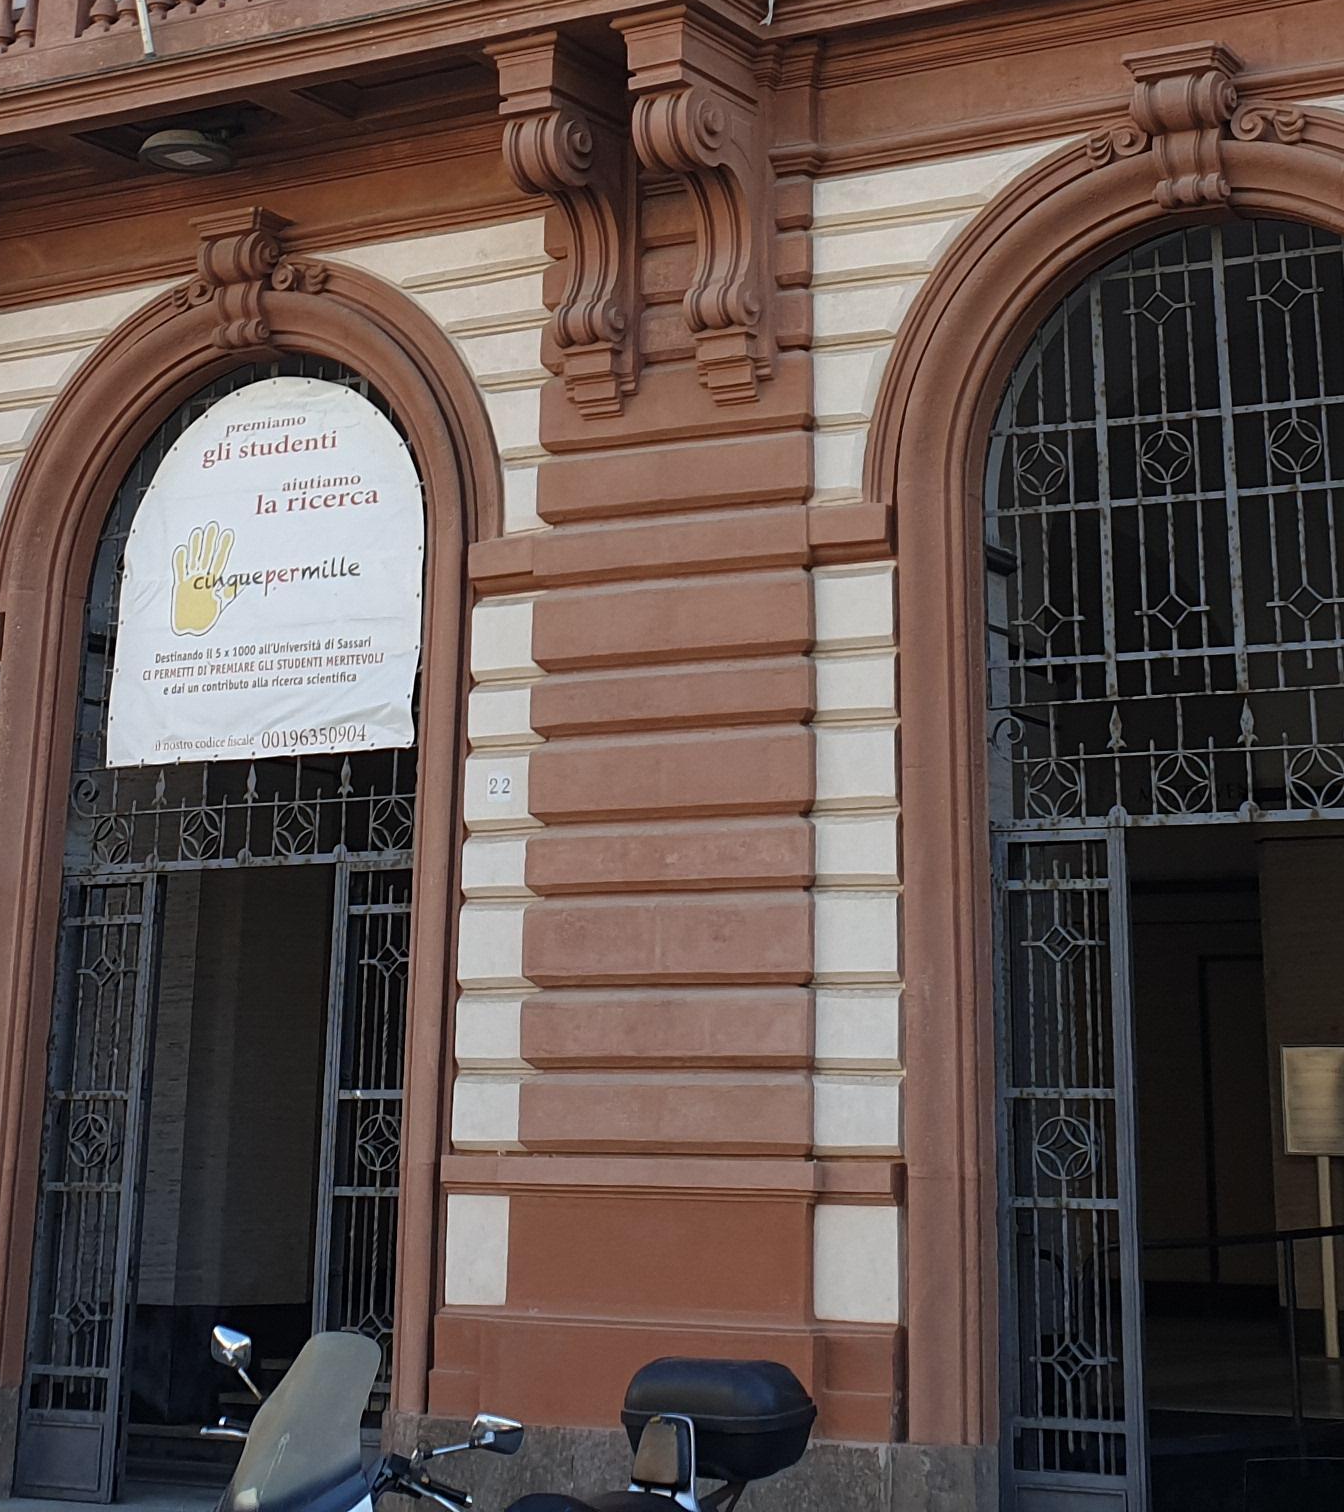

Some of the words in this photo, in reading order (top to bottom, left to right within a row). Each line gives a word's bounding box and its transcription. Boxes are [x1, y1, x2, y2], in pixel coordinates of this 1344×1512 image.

[225, 416, 307, 438] premiamo
[202, 441, 231, 469] gli
[238, 430, 338, 459] studenti
[281, 474, 362, 492] aiutiamo
[255, 494, 278, 516] la
[286, 489, 380, 513] ricerca
[193, 555, 361, 598] cinquepermille
[155, 650, 204, 664] Destinando
[206, 648, 213, 659] il
[215, 648, 222, 659] 5
[224, 650, 230, 658] x
[232, 645, 256, 657] 1000
[258, 639, 321, 655] all'Università
[324, 638, 334, 650] di
[337, 636, 372, 649] Sassari
[142, 670, 152, 681] CI
[154, 666, 195, 680] PERMETTI
[197, 665, 207, 676] DI
[210, 661, 256, 675] PREMIARE
[258, 659, 274, 671] GLI
[277, 657, 323, 670] STUDENTI
[326, 652, 385, 667] MERITEVOLI
[171, 683, 185, 694] dai
[188, 685, 199, 694] un
[202, 679, 249, 692] contributo
[252, 676, 269, 688] alla
[272, 675, 304, 687] ricerca
[306, 671, 357, 686] scientifica
[155, 742, 161, 751] il
[163, 739, 193, 751] nostro
[195, 736, 225, 749] codice
[227, 733, 255, 748] fiscale
[261, 723, 368, 749] 00196350904
[488, 777, 511, 795] 22
